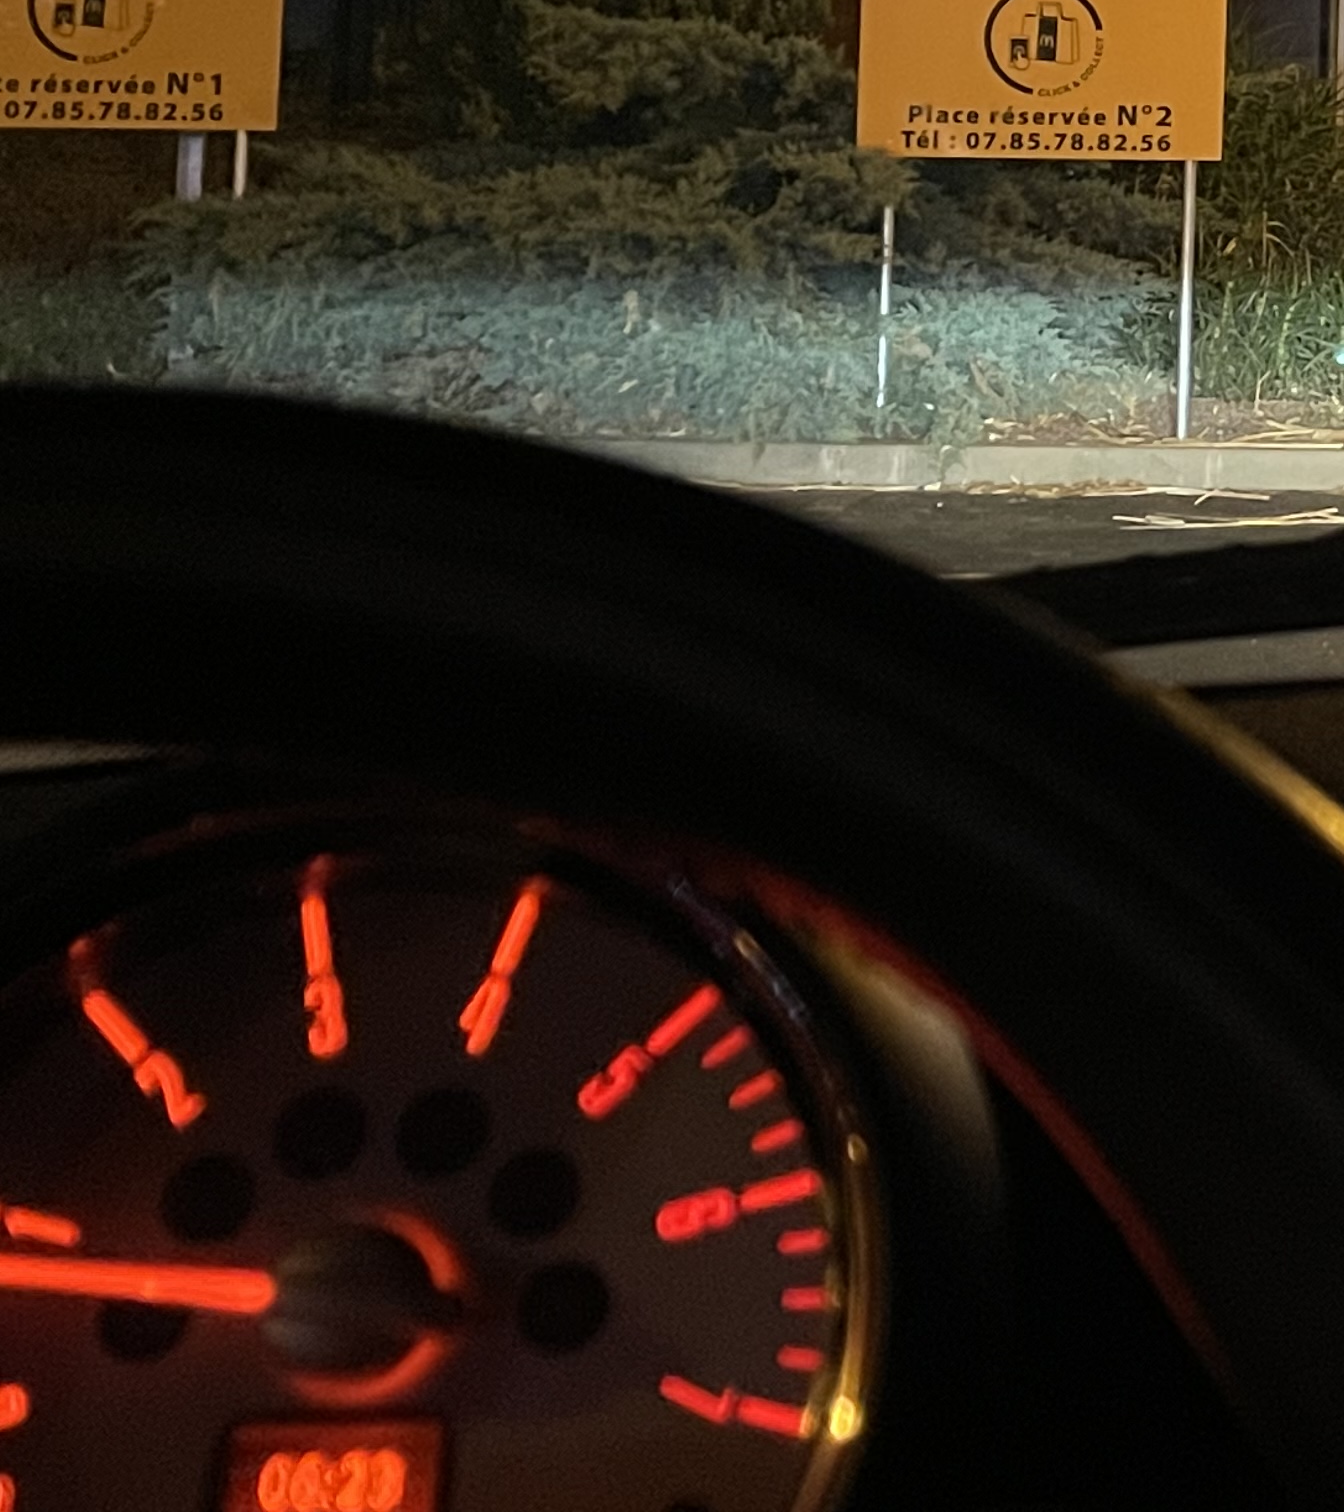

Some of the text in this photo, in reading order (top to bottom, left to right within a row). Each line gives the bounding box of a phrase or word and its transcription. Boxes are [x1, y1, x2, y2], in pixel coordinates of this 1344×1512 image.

[30, 73, 156, 94] réservée
[166, 72, 222, 96] N°1
[4, 99, 224, 121] 07.85.78.82.56
[908, 104, 1172, 127] Place réservée N°2
[901, 130, 939, 150] Tél
[965, 131, 1171, 152] 07.85.78.82.56
[304, 973, 348, 1059] 3
[133, 1048, 207, 1130] 2
[577, 1044, 654, 1121] 5
